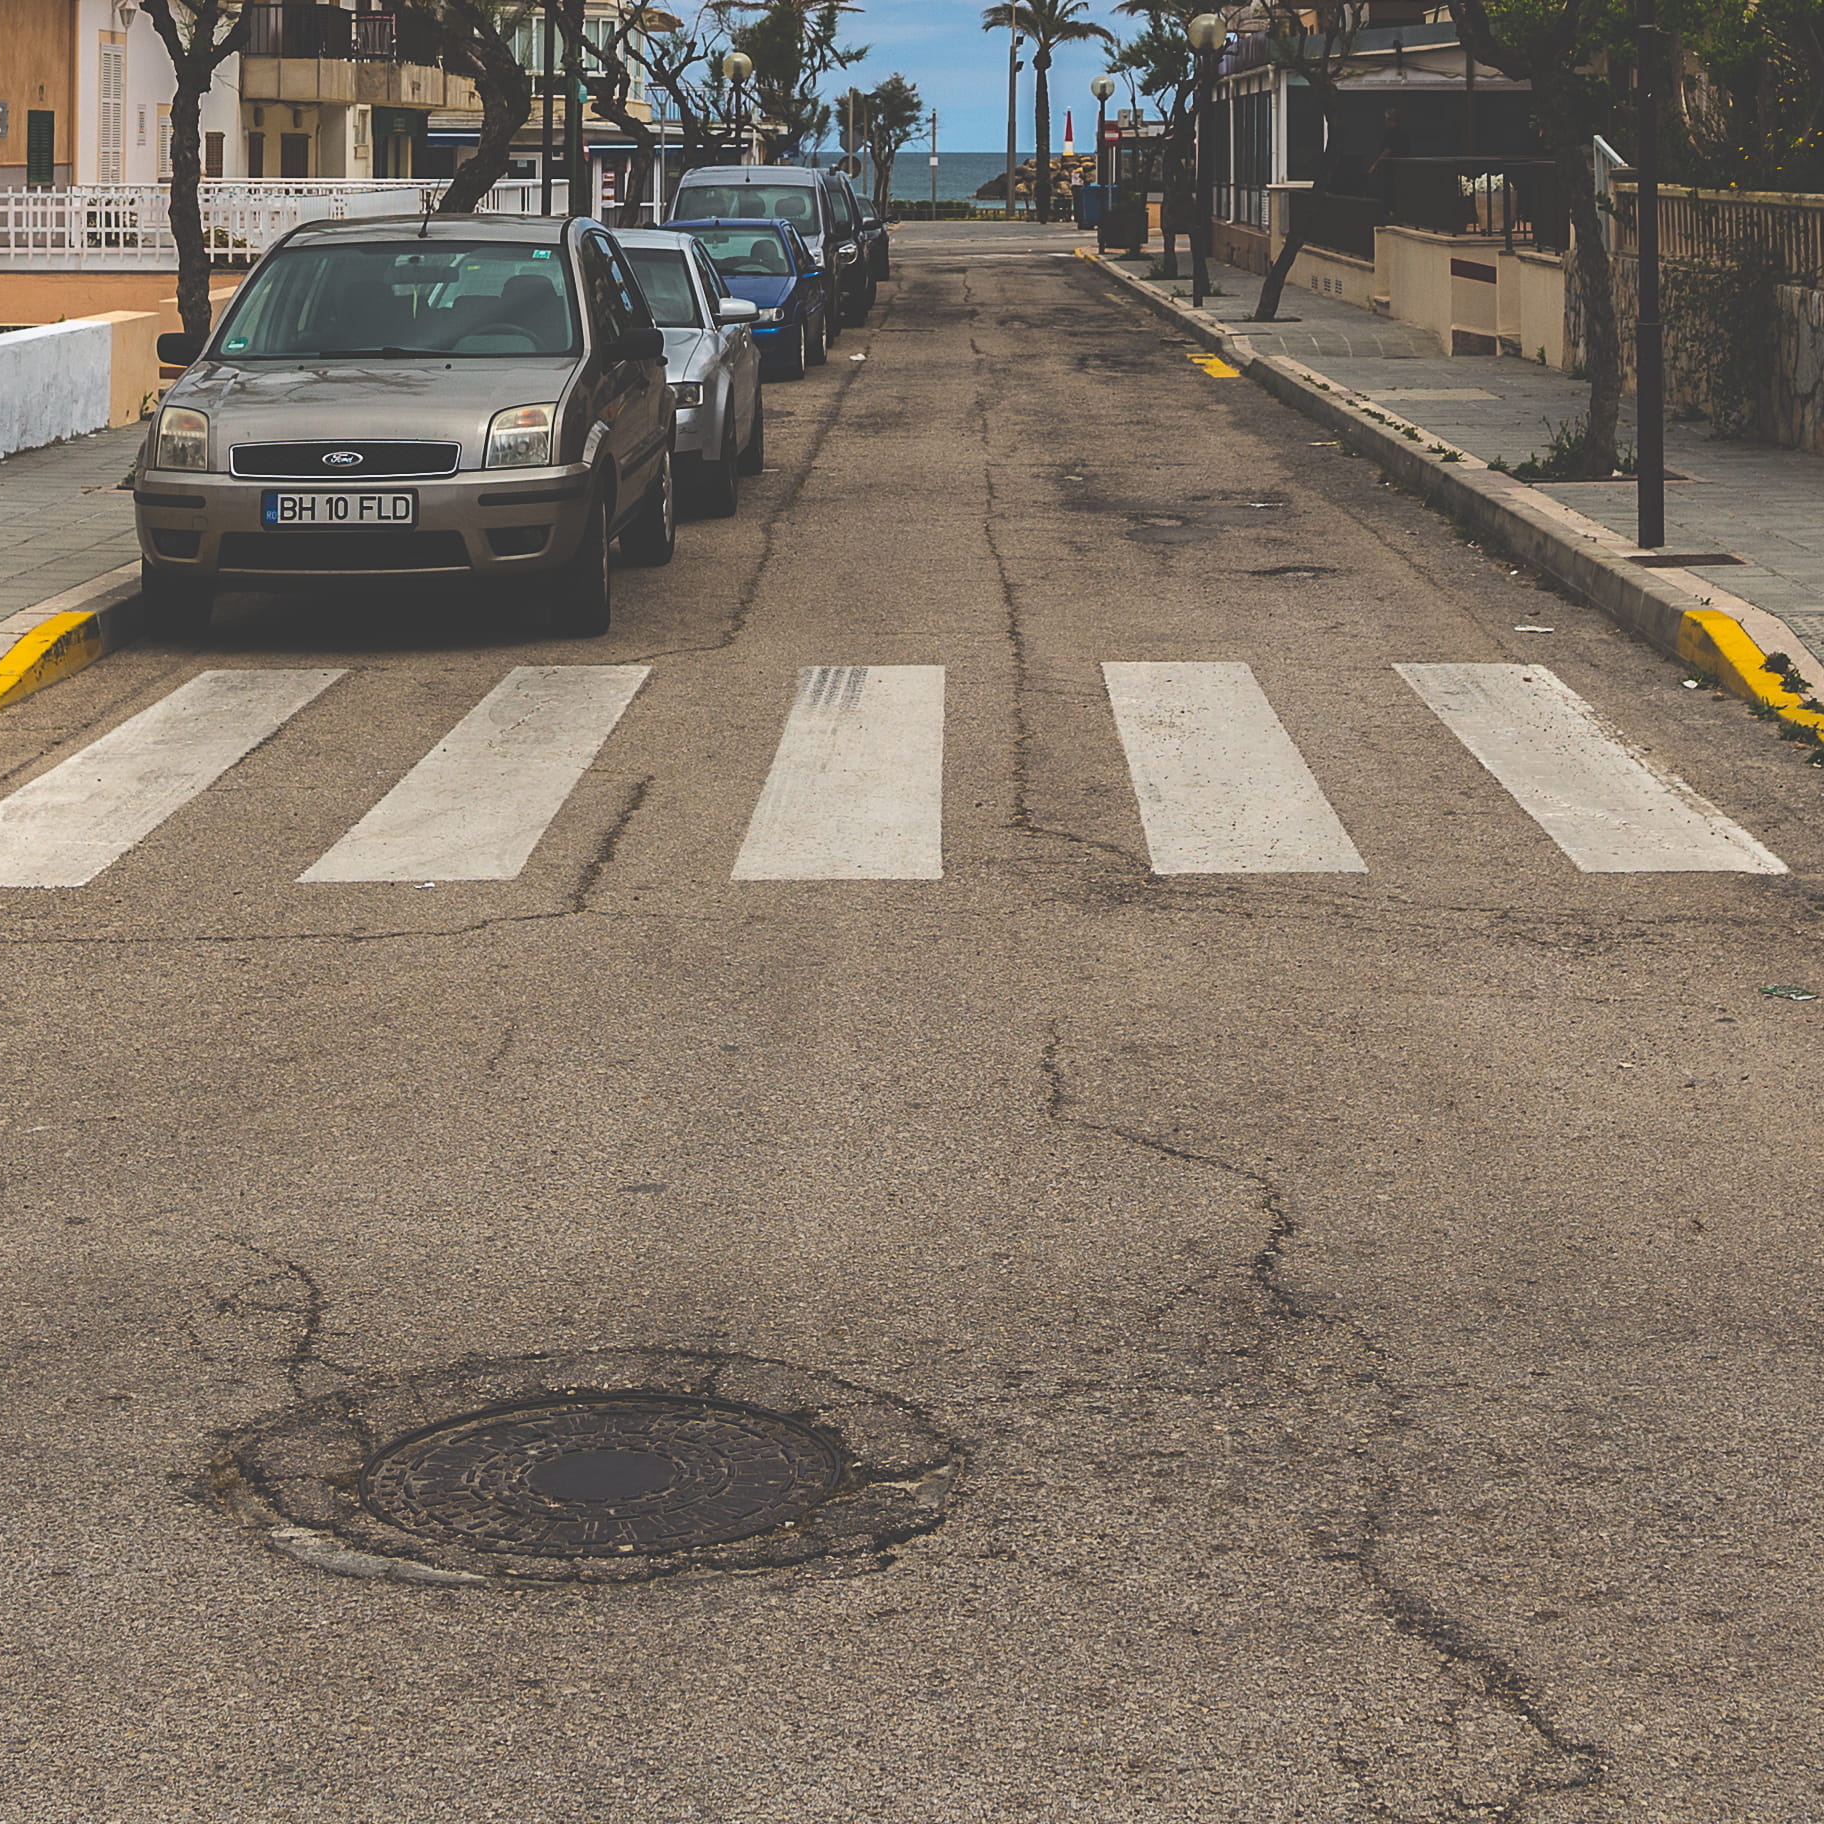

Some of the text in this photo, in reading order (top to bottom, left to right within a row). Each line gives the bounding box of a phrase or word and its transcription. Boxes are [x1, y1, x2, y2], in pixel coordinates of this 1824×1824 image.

[266, 510, 277, 521] RO
[280, 495, 411, 521] BH 10 FLD
